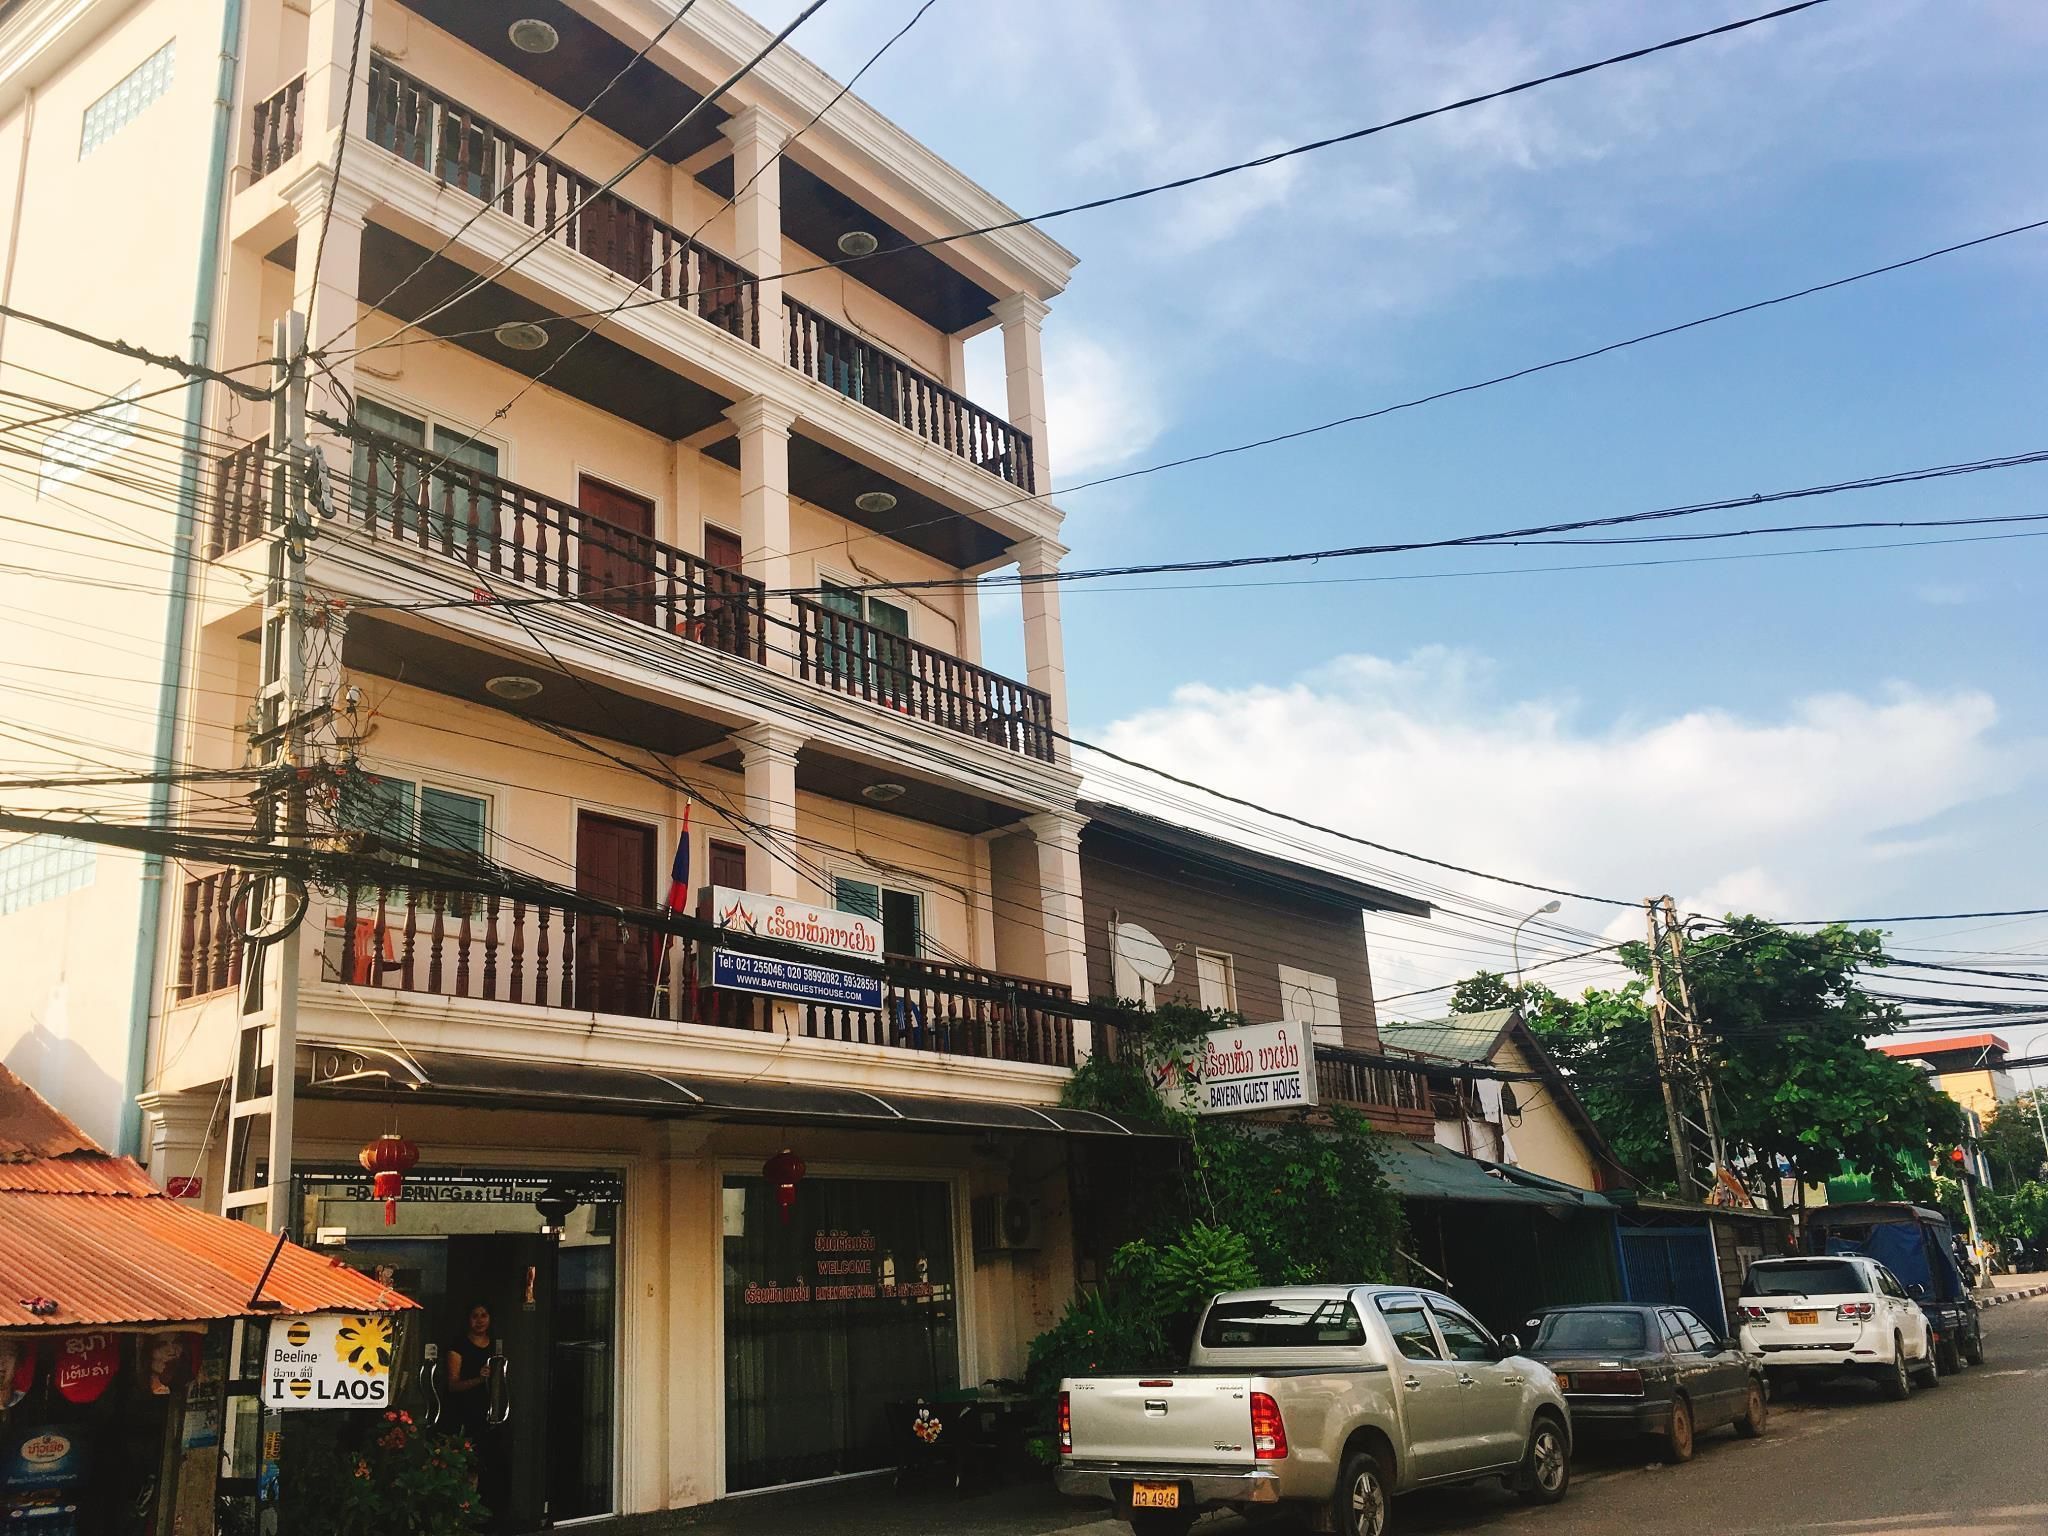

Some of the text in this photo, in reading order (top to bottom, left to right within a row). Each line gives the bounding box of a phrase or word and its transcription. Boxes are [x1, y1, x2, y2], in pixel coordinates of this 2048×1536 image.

[718, 954, 734, 970] Tel:
[736, 958, 752, 972] 021
[753, 960, 785, 977] 255046;
[787, 964, 802, 980] 020
[803, 966, 842, 986] 58992082,
[736, 974, 862, 1001] WWW.BAYERNGUESTHOUSE.COM
[1210, 1077, 1302, 1108] BAYERN GUEST HOUSE
[817, 1259, 872, 1276] WELCOME
[274, 1349, 318, 1364] Beeline
[272, 1379, 385, 1400] I LAOS
